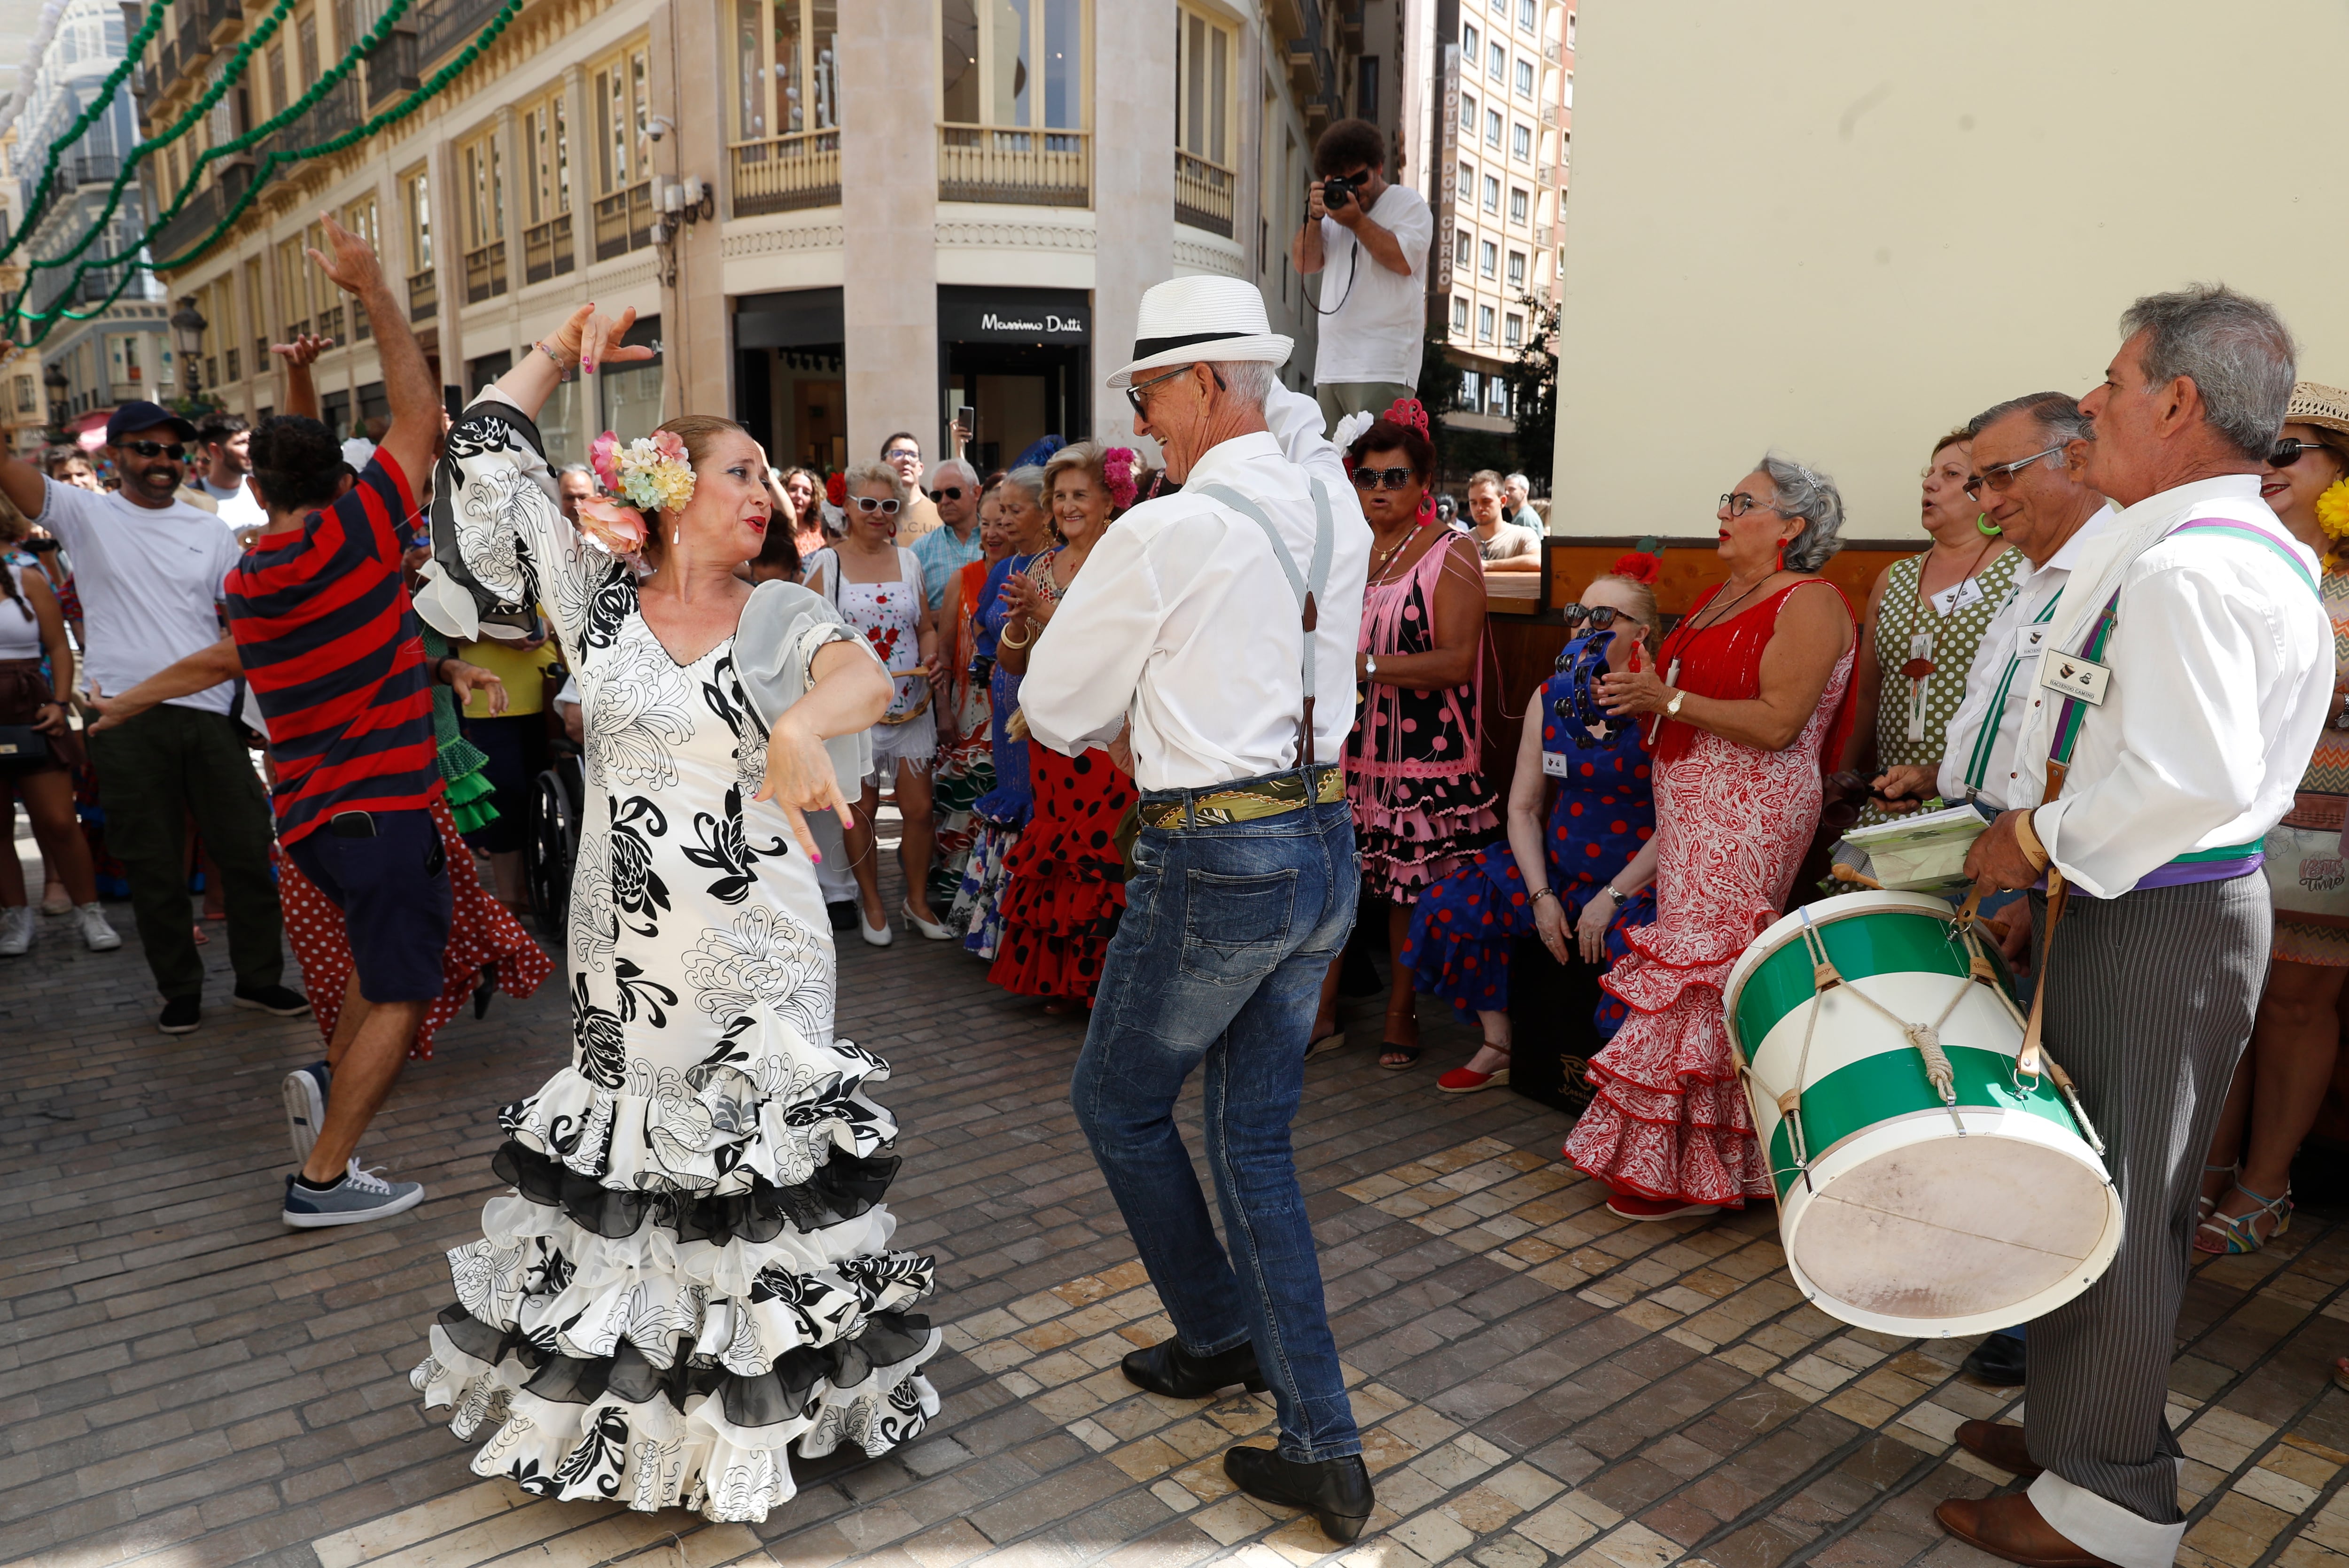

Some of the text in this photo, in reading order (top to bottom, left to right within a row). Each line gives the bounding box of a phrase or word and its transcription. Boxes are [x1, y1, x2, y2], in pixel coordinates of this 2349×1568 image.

[1439, 77, 1458, 286] HOTEL DON CURRO
[981, 313, 1082, 333] Massimo Dutti
[2050, 680, 2094, 699] HACIENDO CAMINO
